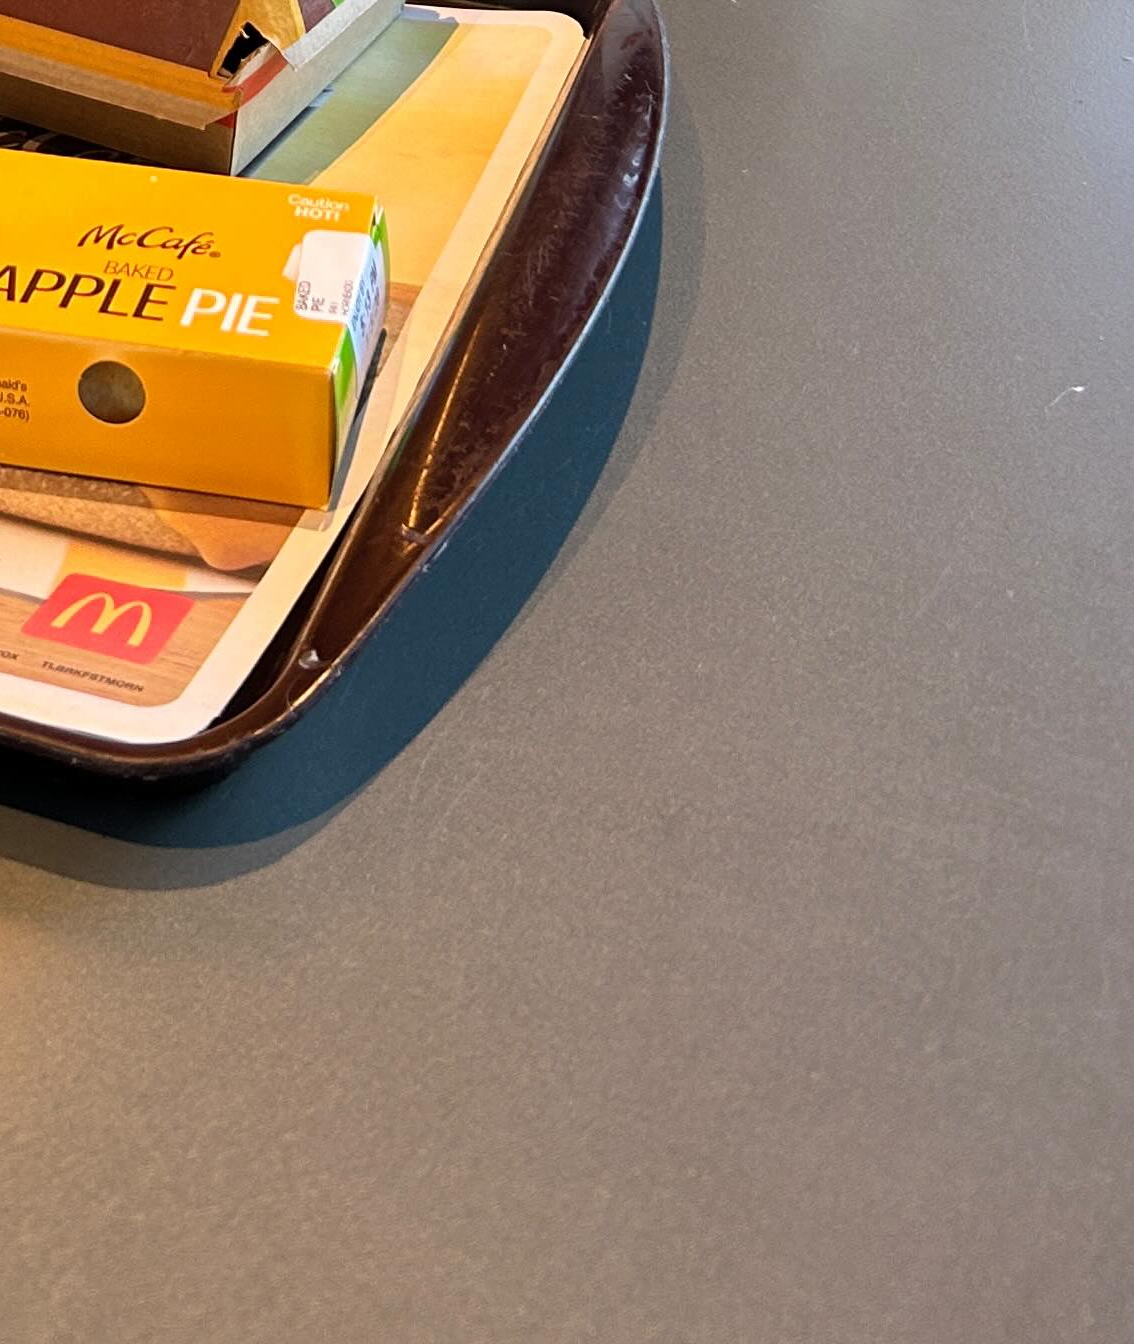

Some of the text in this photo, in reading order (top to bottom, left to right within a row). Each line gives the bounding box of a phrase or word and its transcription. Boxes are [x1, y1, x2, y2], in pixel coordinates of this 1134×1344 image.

[287, 192, 351, 212] Caution
[293, 207, 341, 222] HOT!
[103, 259, 175, 282] BAKED
[179, 287, 281, 337] PIE
